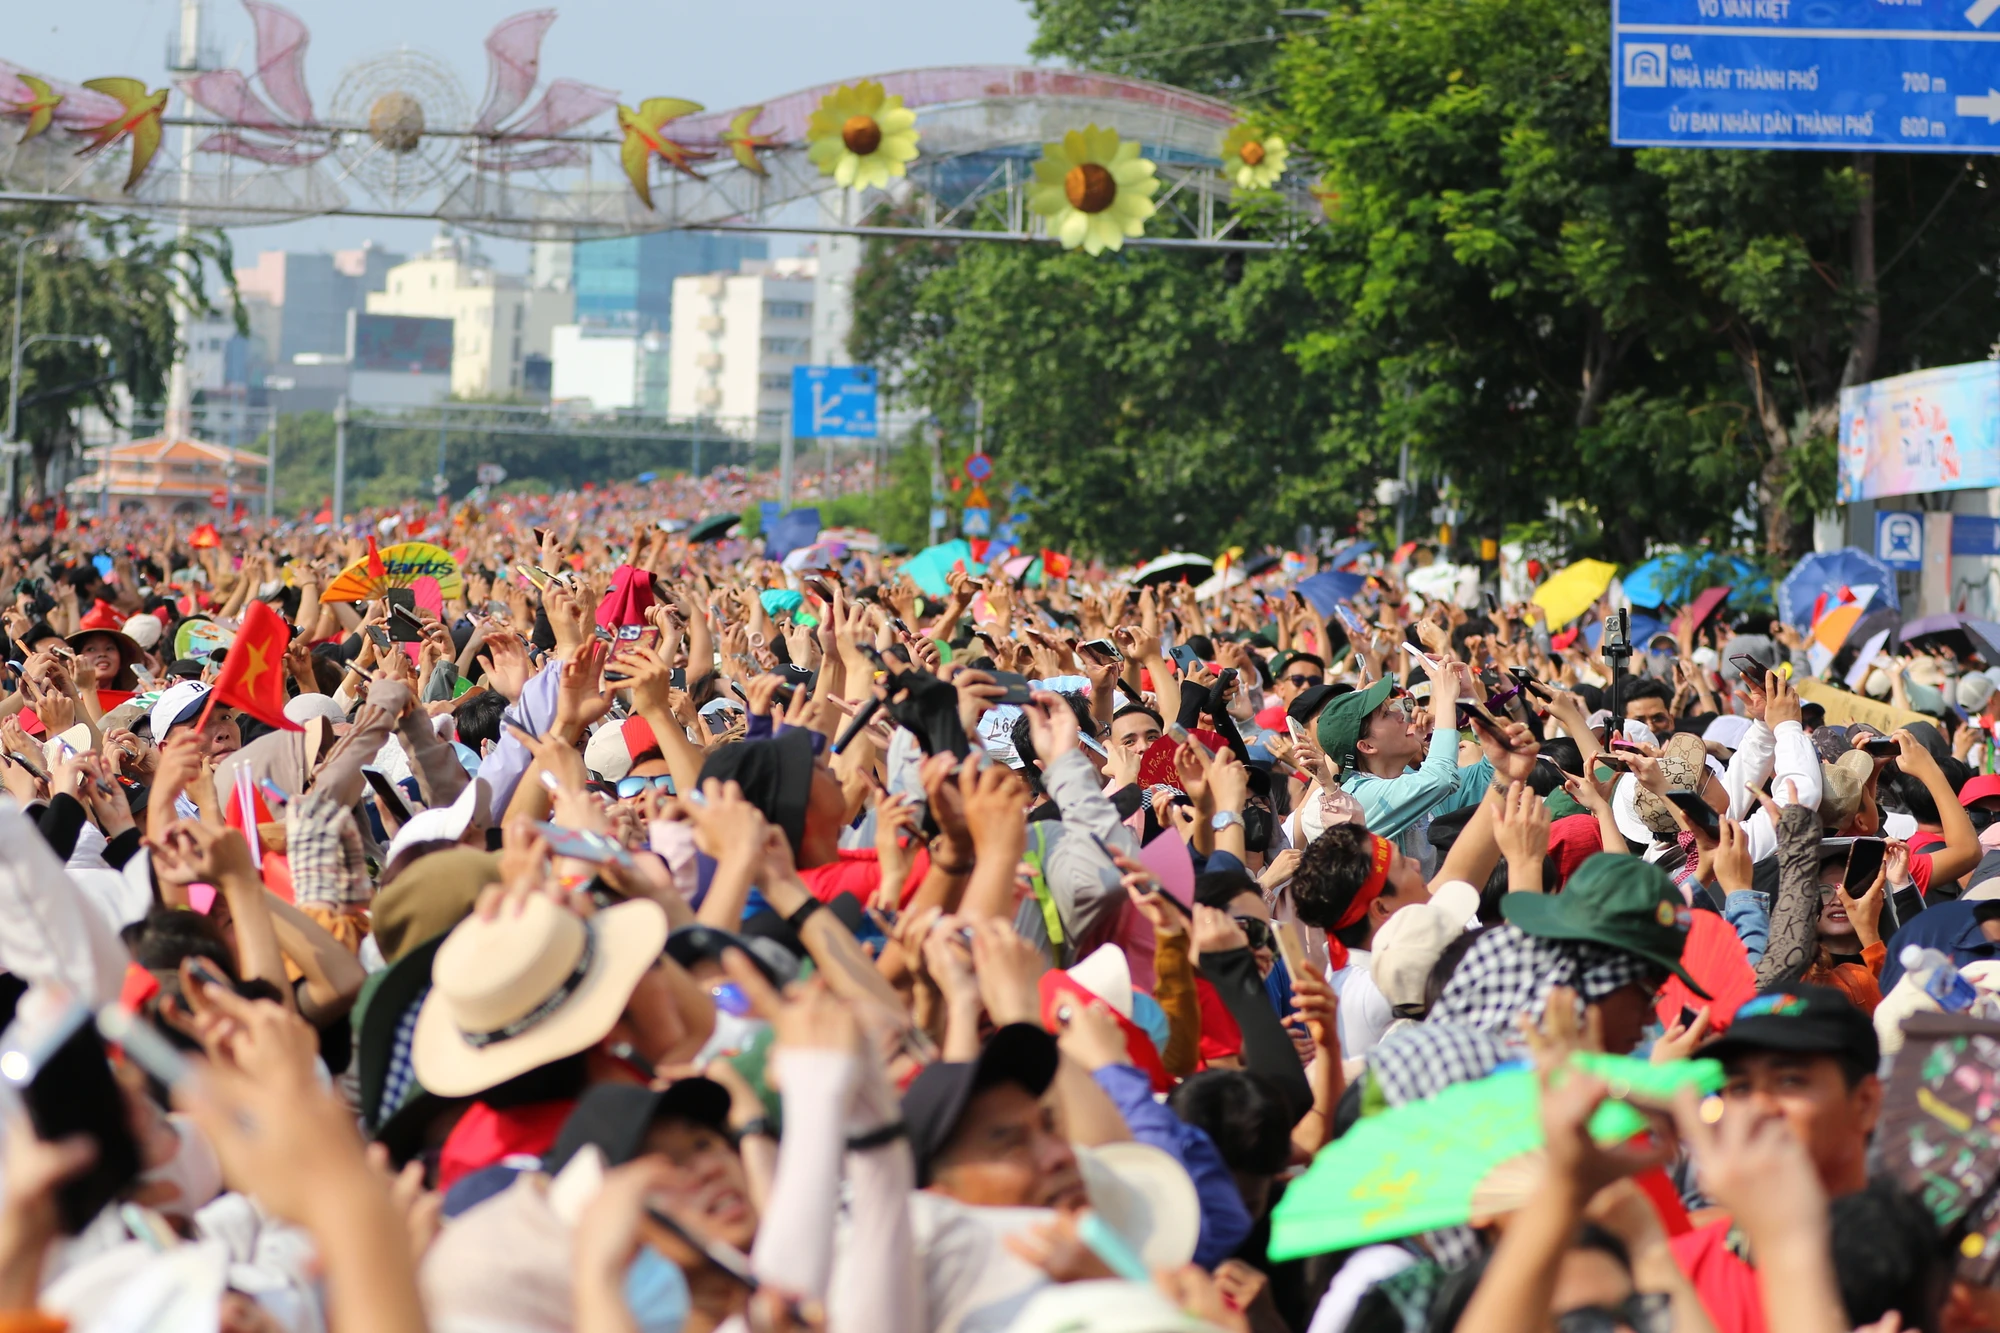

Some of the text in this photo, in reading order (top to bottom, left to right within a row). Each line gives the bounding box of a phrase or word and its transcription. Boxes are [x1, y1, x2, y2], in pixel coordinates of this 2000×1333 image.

[1670, 44, 1693, 61] GA
[1670, 63, 1820, 92] NHÀ HÁT THÀNH PHỐ
[1902, 71, 1947, 93] 700 m
[1690, 112, 1720, 133] BAN
[1721, 109, 1761, 134] NHÂN
[1763, 110, 1793, 135] DÂN
[1794, 108, 1843, 136] THÀNH
[1844, 109, 1876, 137] PHỐ
[1930, 121, 1947, 137] m
[188, 682, 205, 693] B
